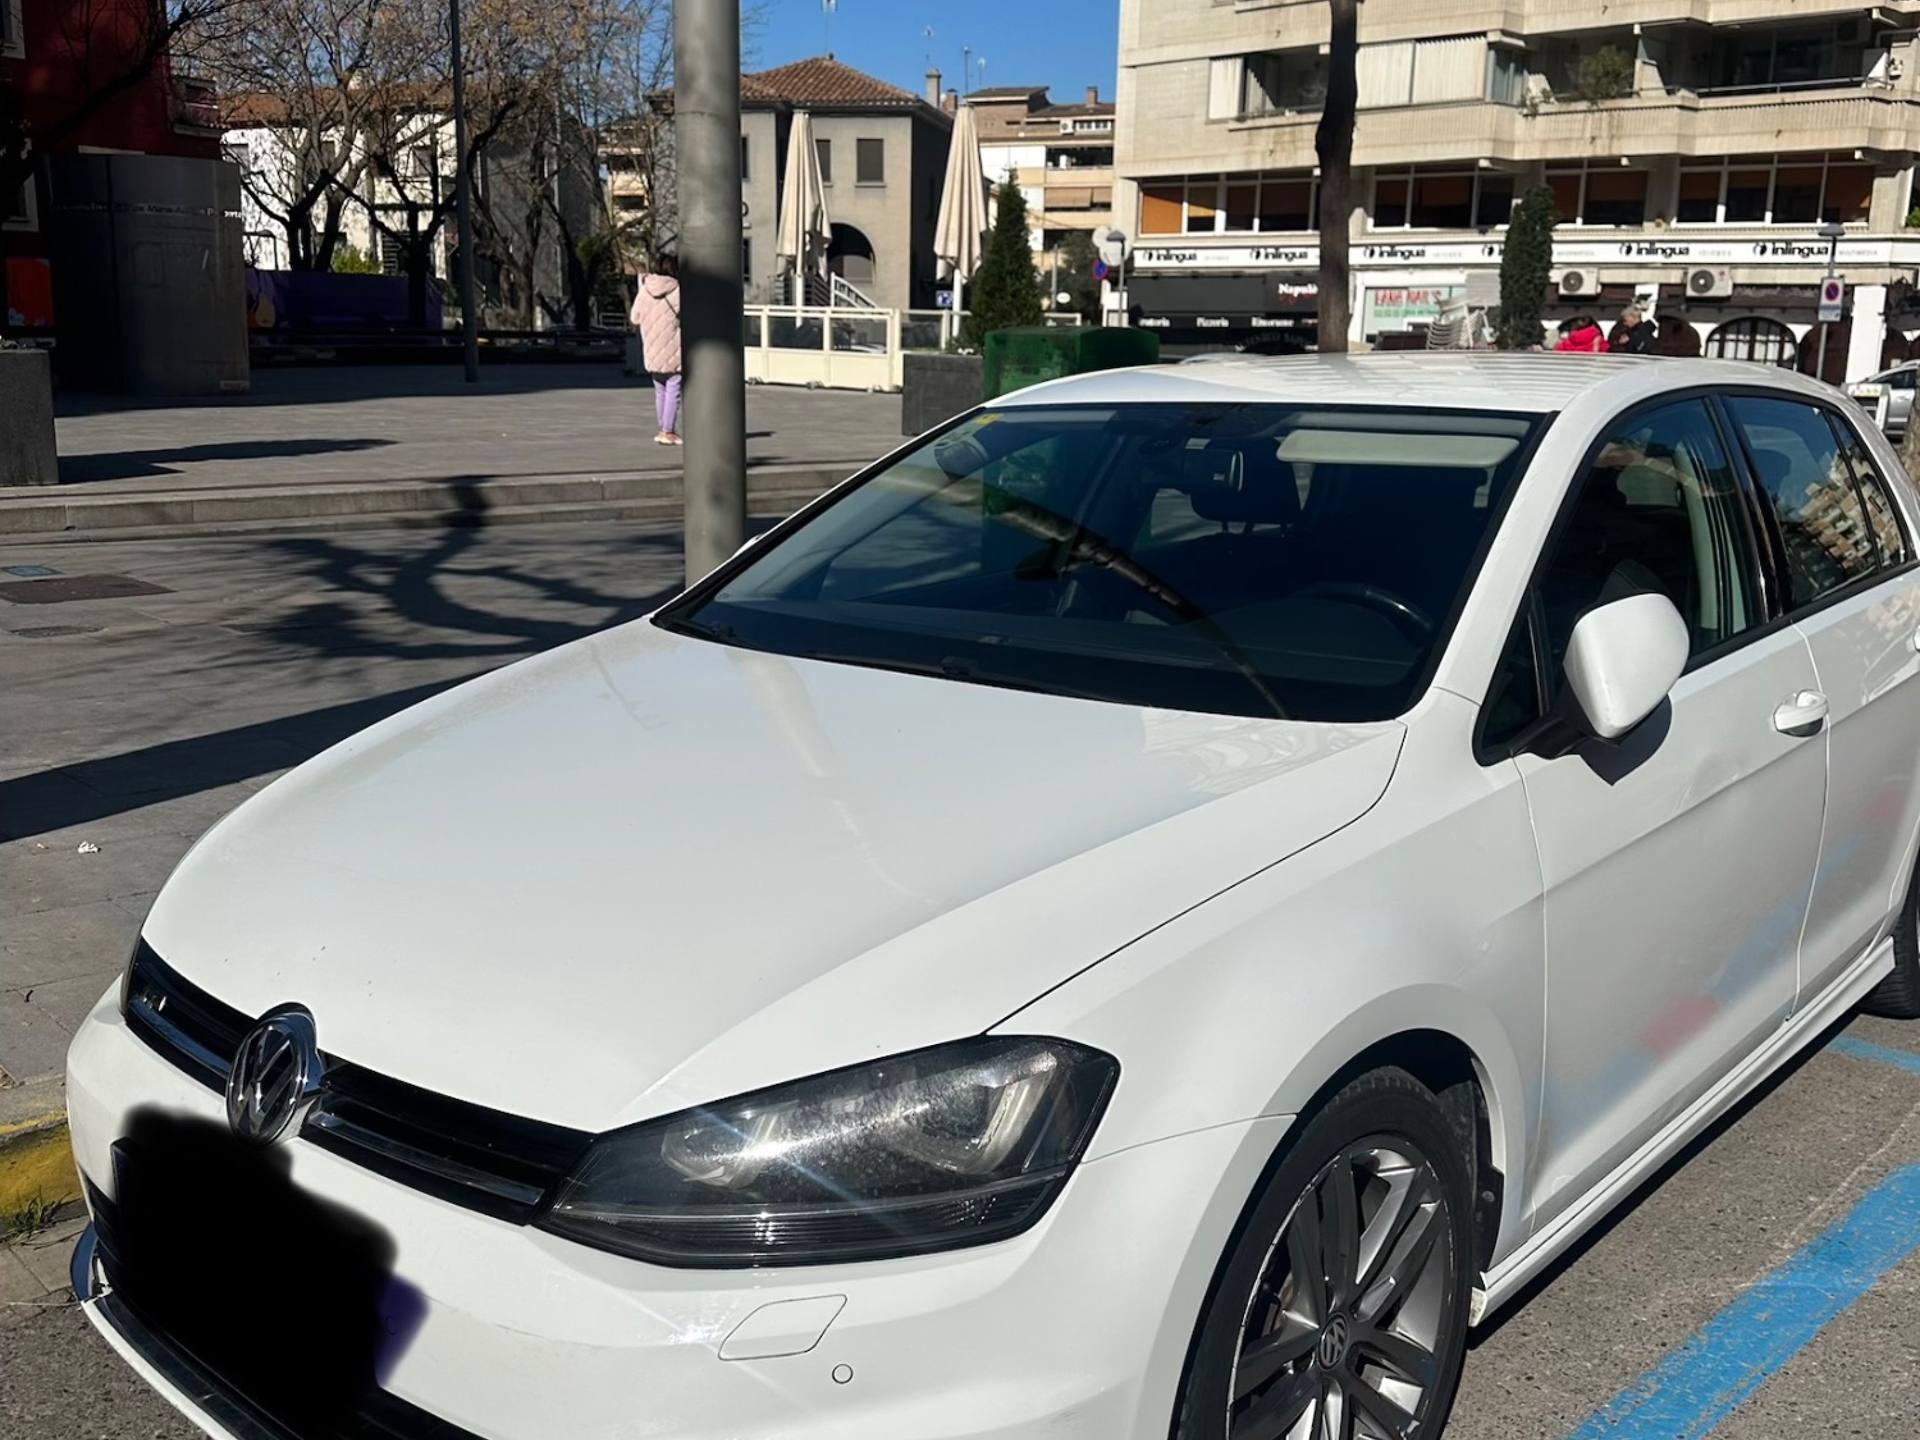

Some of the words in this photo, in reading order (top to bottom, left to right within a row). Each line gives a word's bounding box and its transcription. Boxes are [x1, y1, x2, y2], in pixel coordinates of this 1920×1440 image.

[1156, 248, 1197, 263] inlingua
[1264, 247, 1308, 262] inlingua
[1378, 245, 1426, 260] inlingua
[1636, 242, 1690, 258] inlingua
[1771, 242, 1829, 258] inlingua
